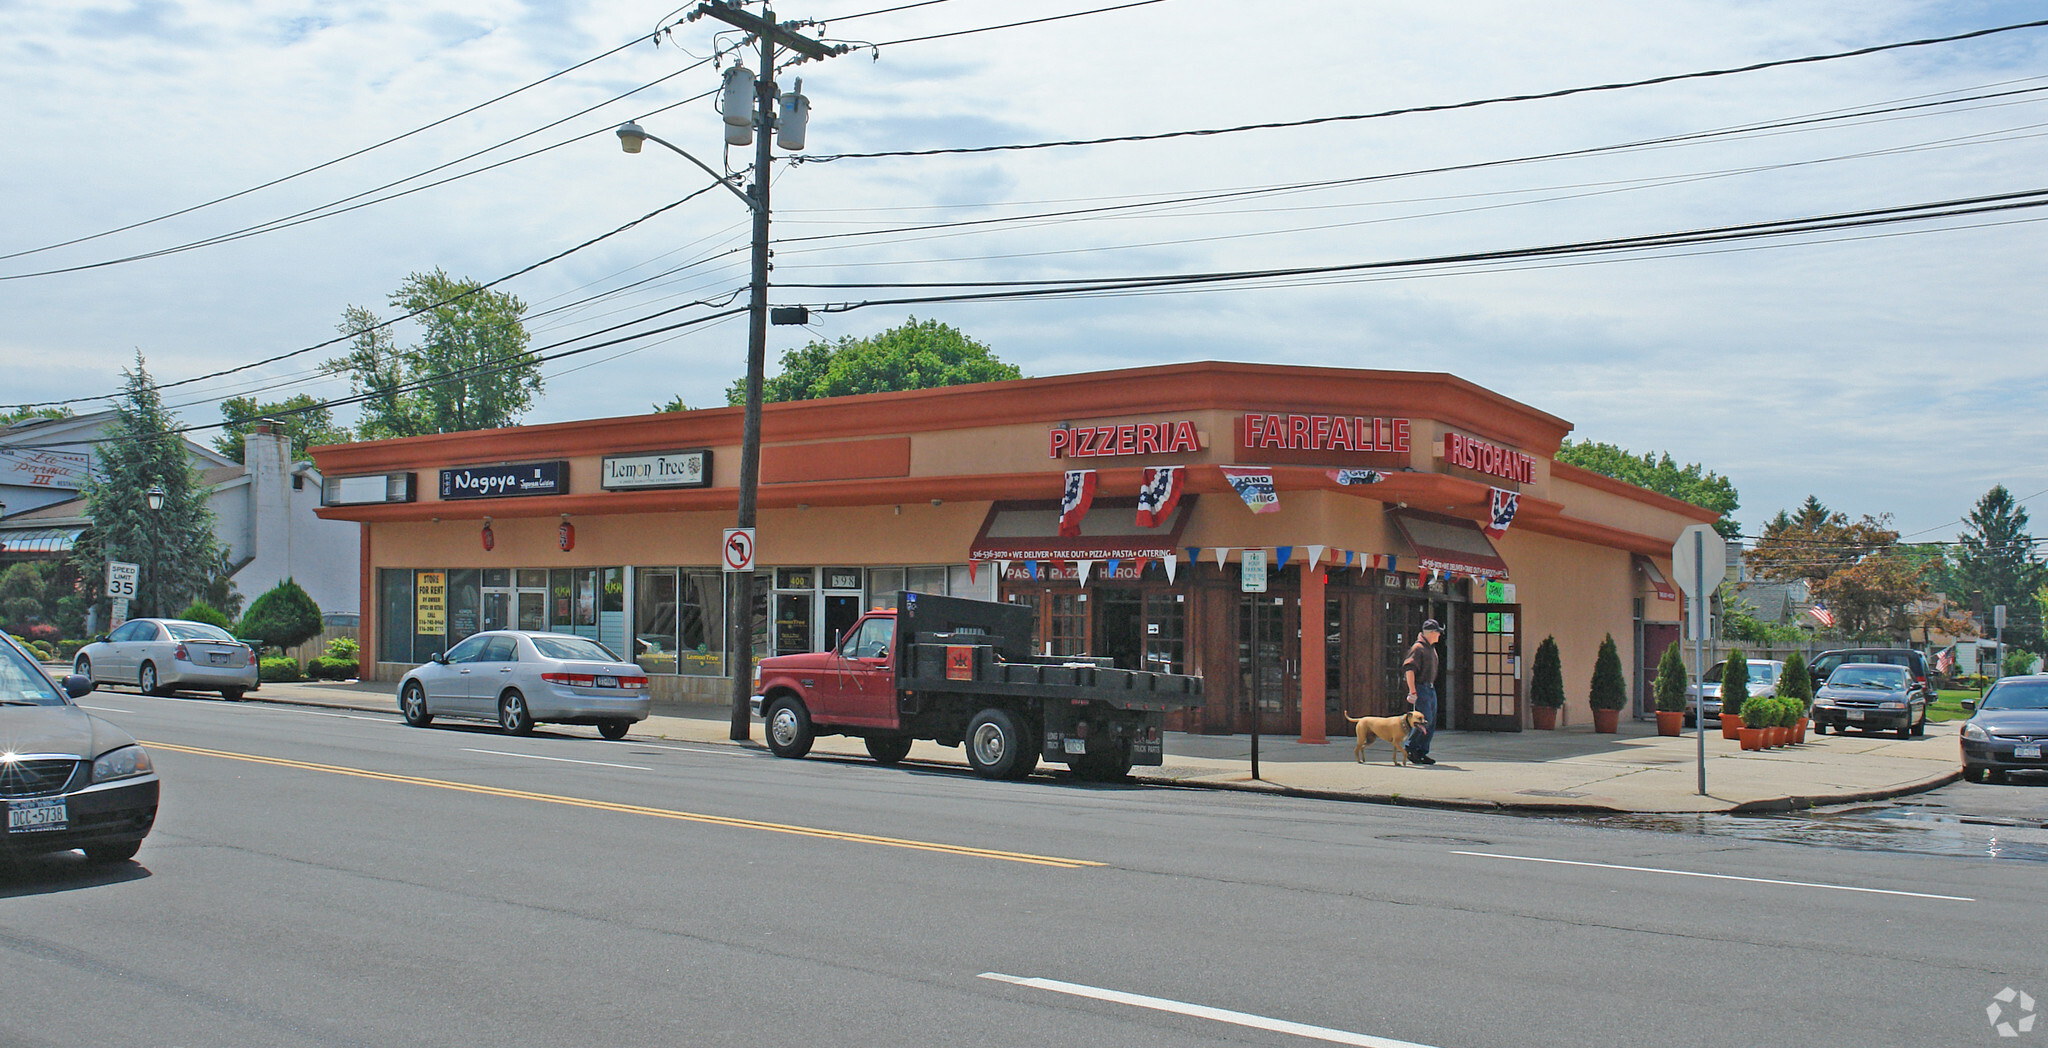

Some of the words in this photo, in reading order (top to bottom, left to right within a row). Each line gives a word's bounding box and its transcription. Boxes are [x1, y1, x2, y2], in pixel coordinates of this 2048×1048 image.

[1244, 413, 1410, 452] FARFALLE
[1049, 420, 1197, 459] PIZZERIA
[1452, 432, 1537, 485] RISTORANTE
[611, 459, 651, 479] Lemon
[657, 457, 685, 476] Tree
[30, 474, 54, 485] III
[455, 470, 516, 494] Nagoya
[973, 550, 1008, 559] 516-536-3070
[1024, 550, 1049, 558] DELIVER
[1053, 550, 1070, 558] TAKE
[1071, 550, 1085, 558] OUT
[1089, 550, 1108, 558] PIZZA
[1112, 549, 1133, 558] PASTA
[1137, 549, 1171, 558] CATERING
[112, 566, 136, 574] SPEED
[423, 574, 440, 584] STORE
[790, 577, 805, 585] 400
[833, 575, 855, 587] 398
[110, 580, 134, 595] 35
[419, 586, 429, 594] FOR
[430, 586, 443, 594] RENT
[1134, 744, 1147, 753] TRUCK
[1147, 745, 1160, 753] PARTS
